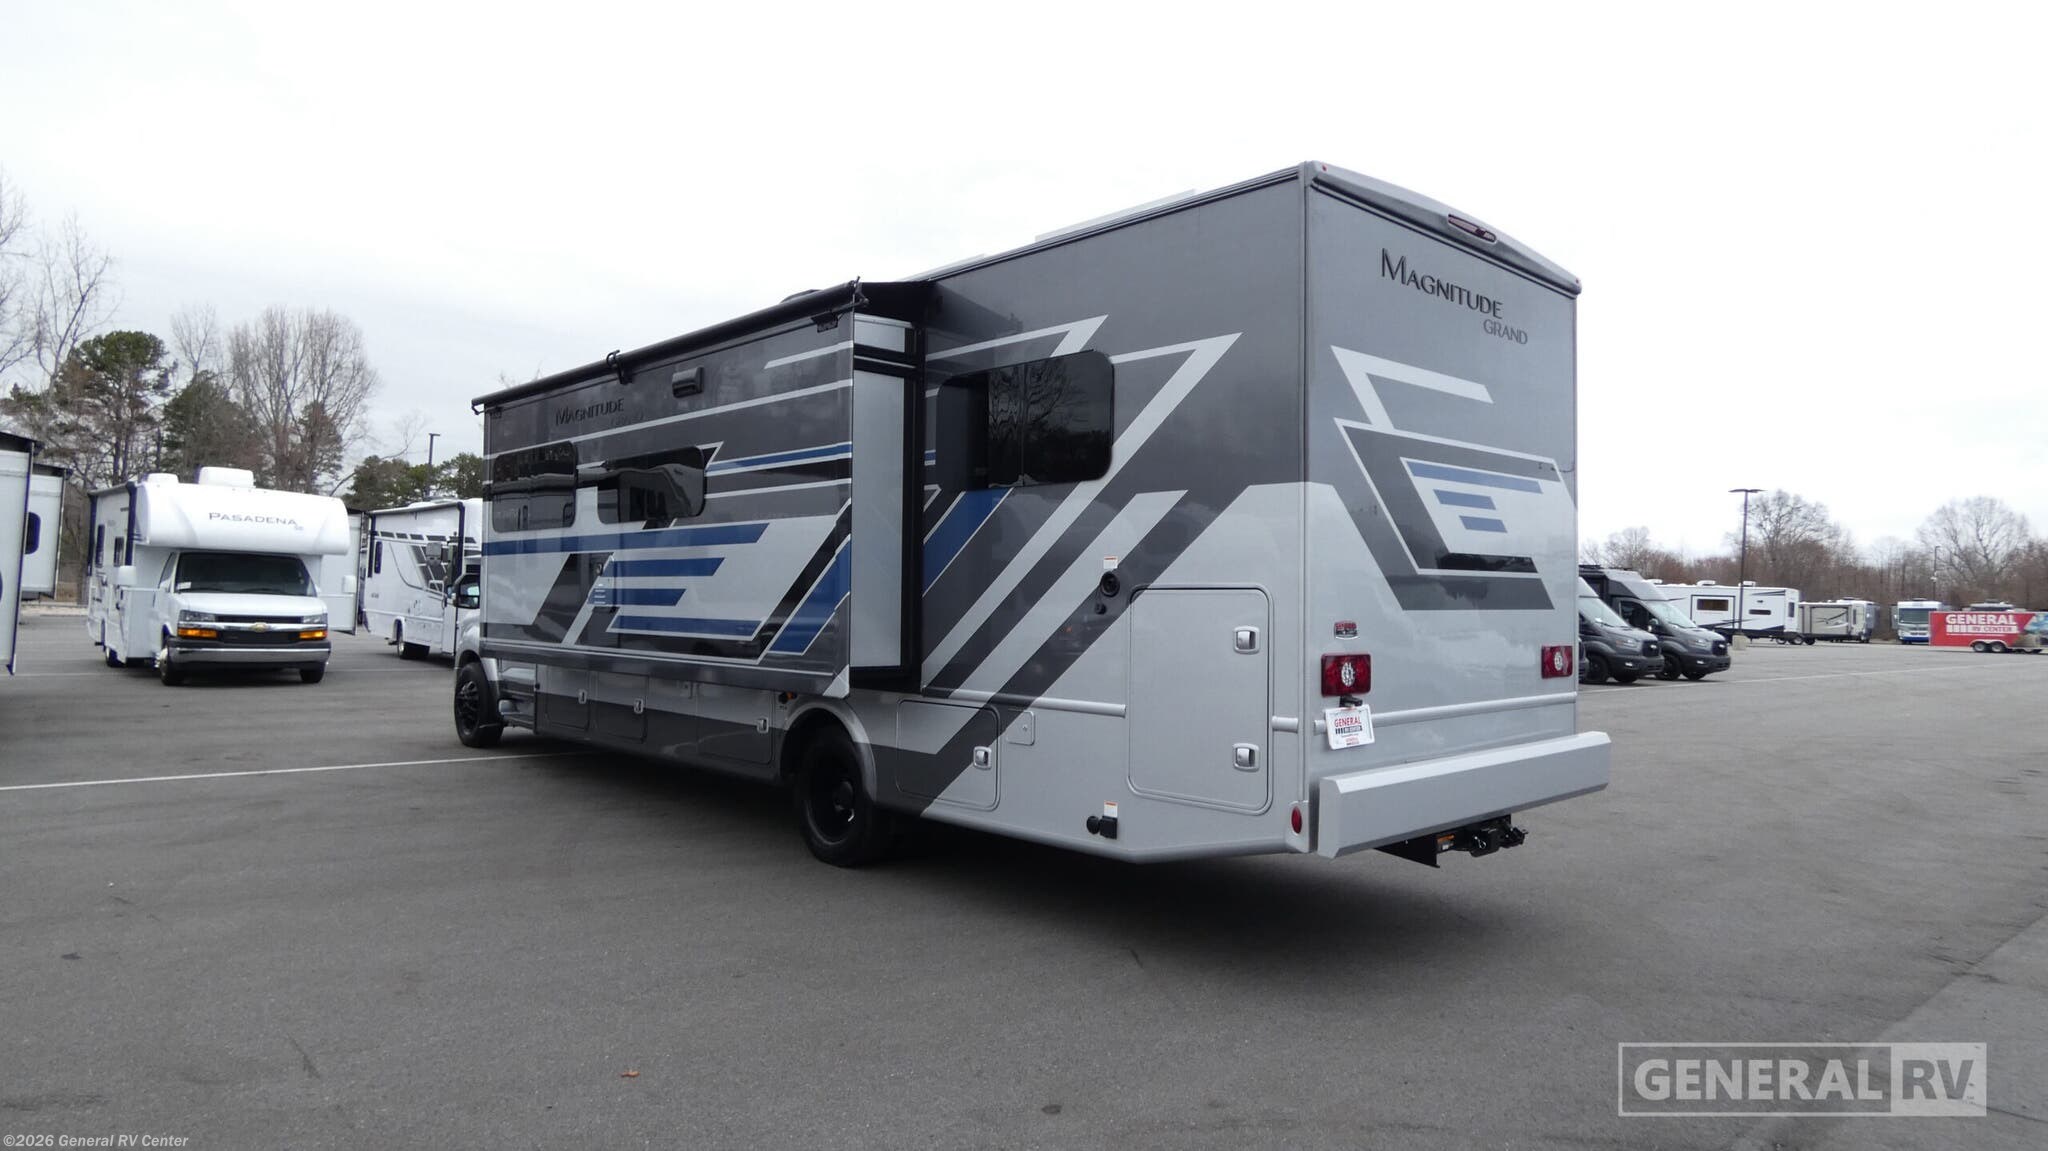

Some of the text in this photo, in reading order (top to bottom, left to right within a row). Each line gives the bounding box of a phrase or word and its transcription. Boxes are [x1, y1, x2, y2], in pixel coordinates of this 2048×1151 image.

[1382, 248, 1503, 319] MAGNITUDE
[1483, 319, 1528, 345] GRAND
[556, 399, 624, 426] MAGNITUDE
[209, 512, 297, 526] PASADENA
[1945, 614, 2017, 625] GENERAL
[1334, 715, 1362, 728] GENERAL
